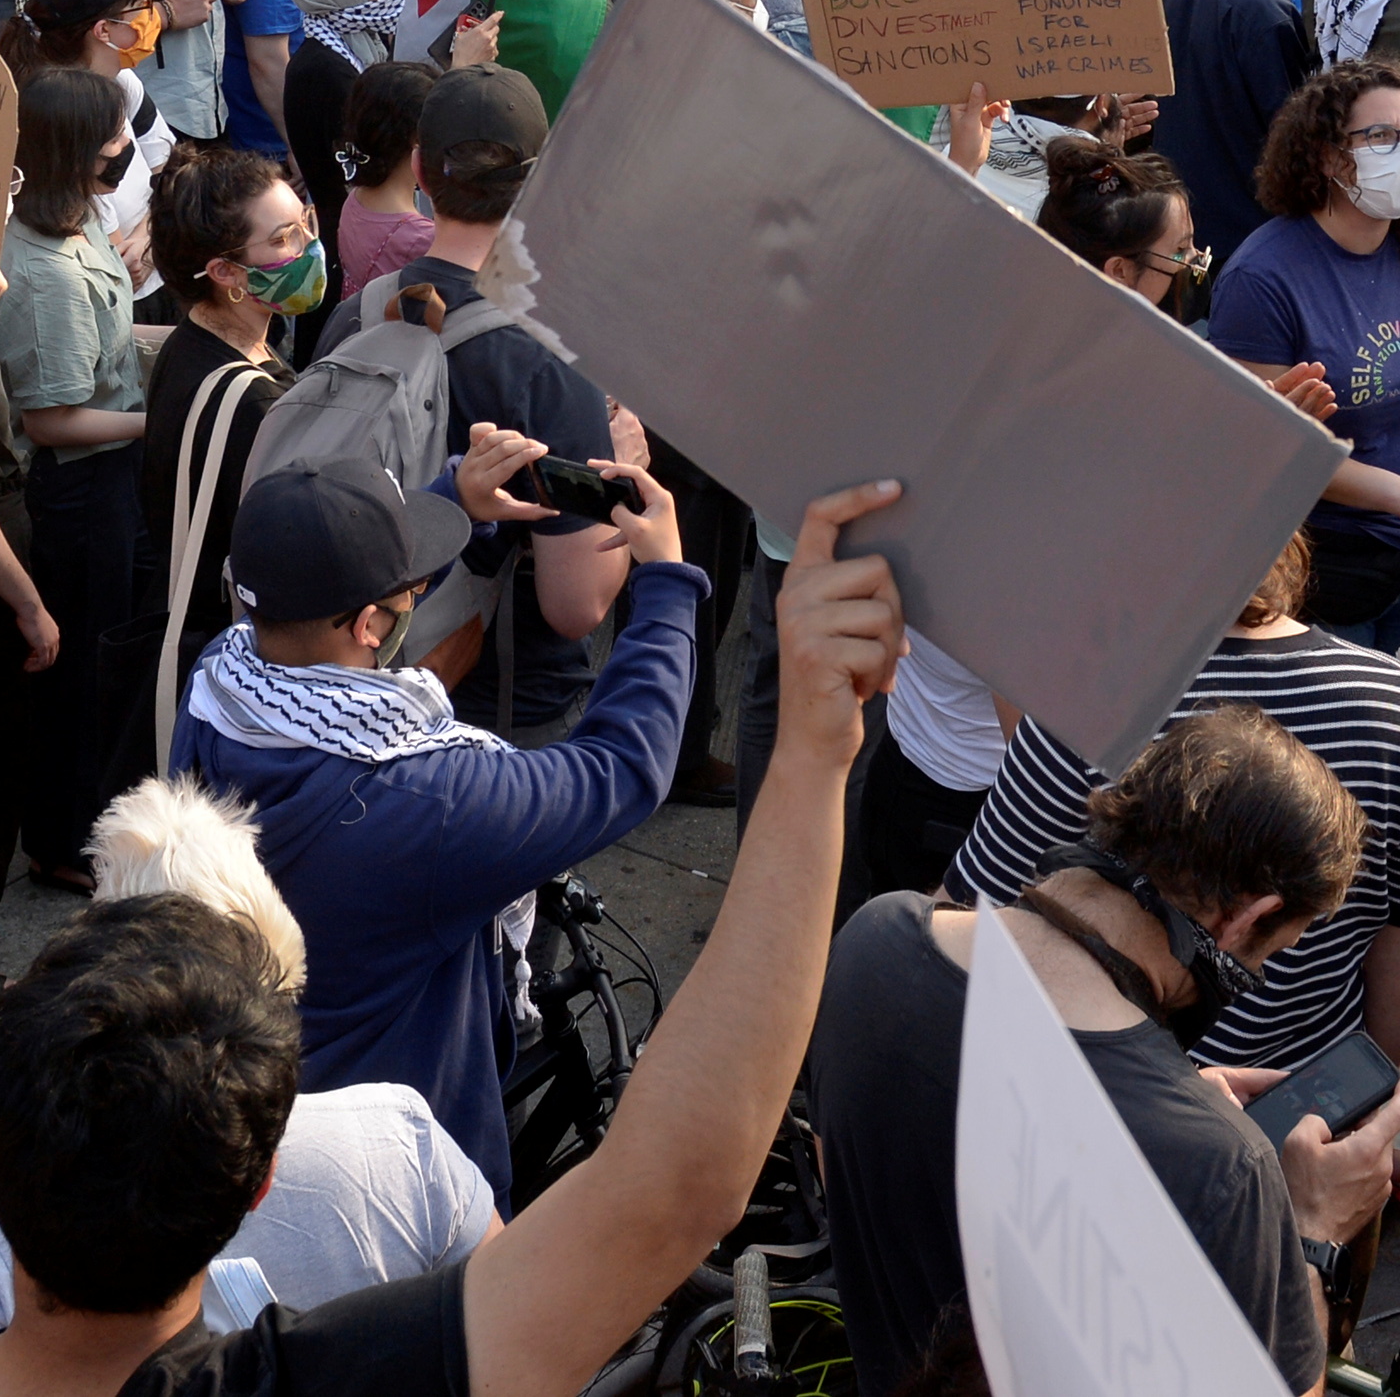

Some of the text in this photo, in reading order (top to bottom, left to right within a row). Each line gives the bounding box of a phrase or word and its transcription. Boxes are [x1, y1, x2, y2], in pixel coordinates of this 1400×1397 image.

[831, 10, 997, 39] DIVESTMENT
[1043, 14, 1090, 31] FOR
[837, 40, 991, 76] SANCTIONS
[1016, 34, 1114, 56] ISRAELI
[1016, 55, 1155, 80] WAR CRIMES
[1351, 345, 1373, 405] SELF
